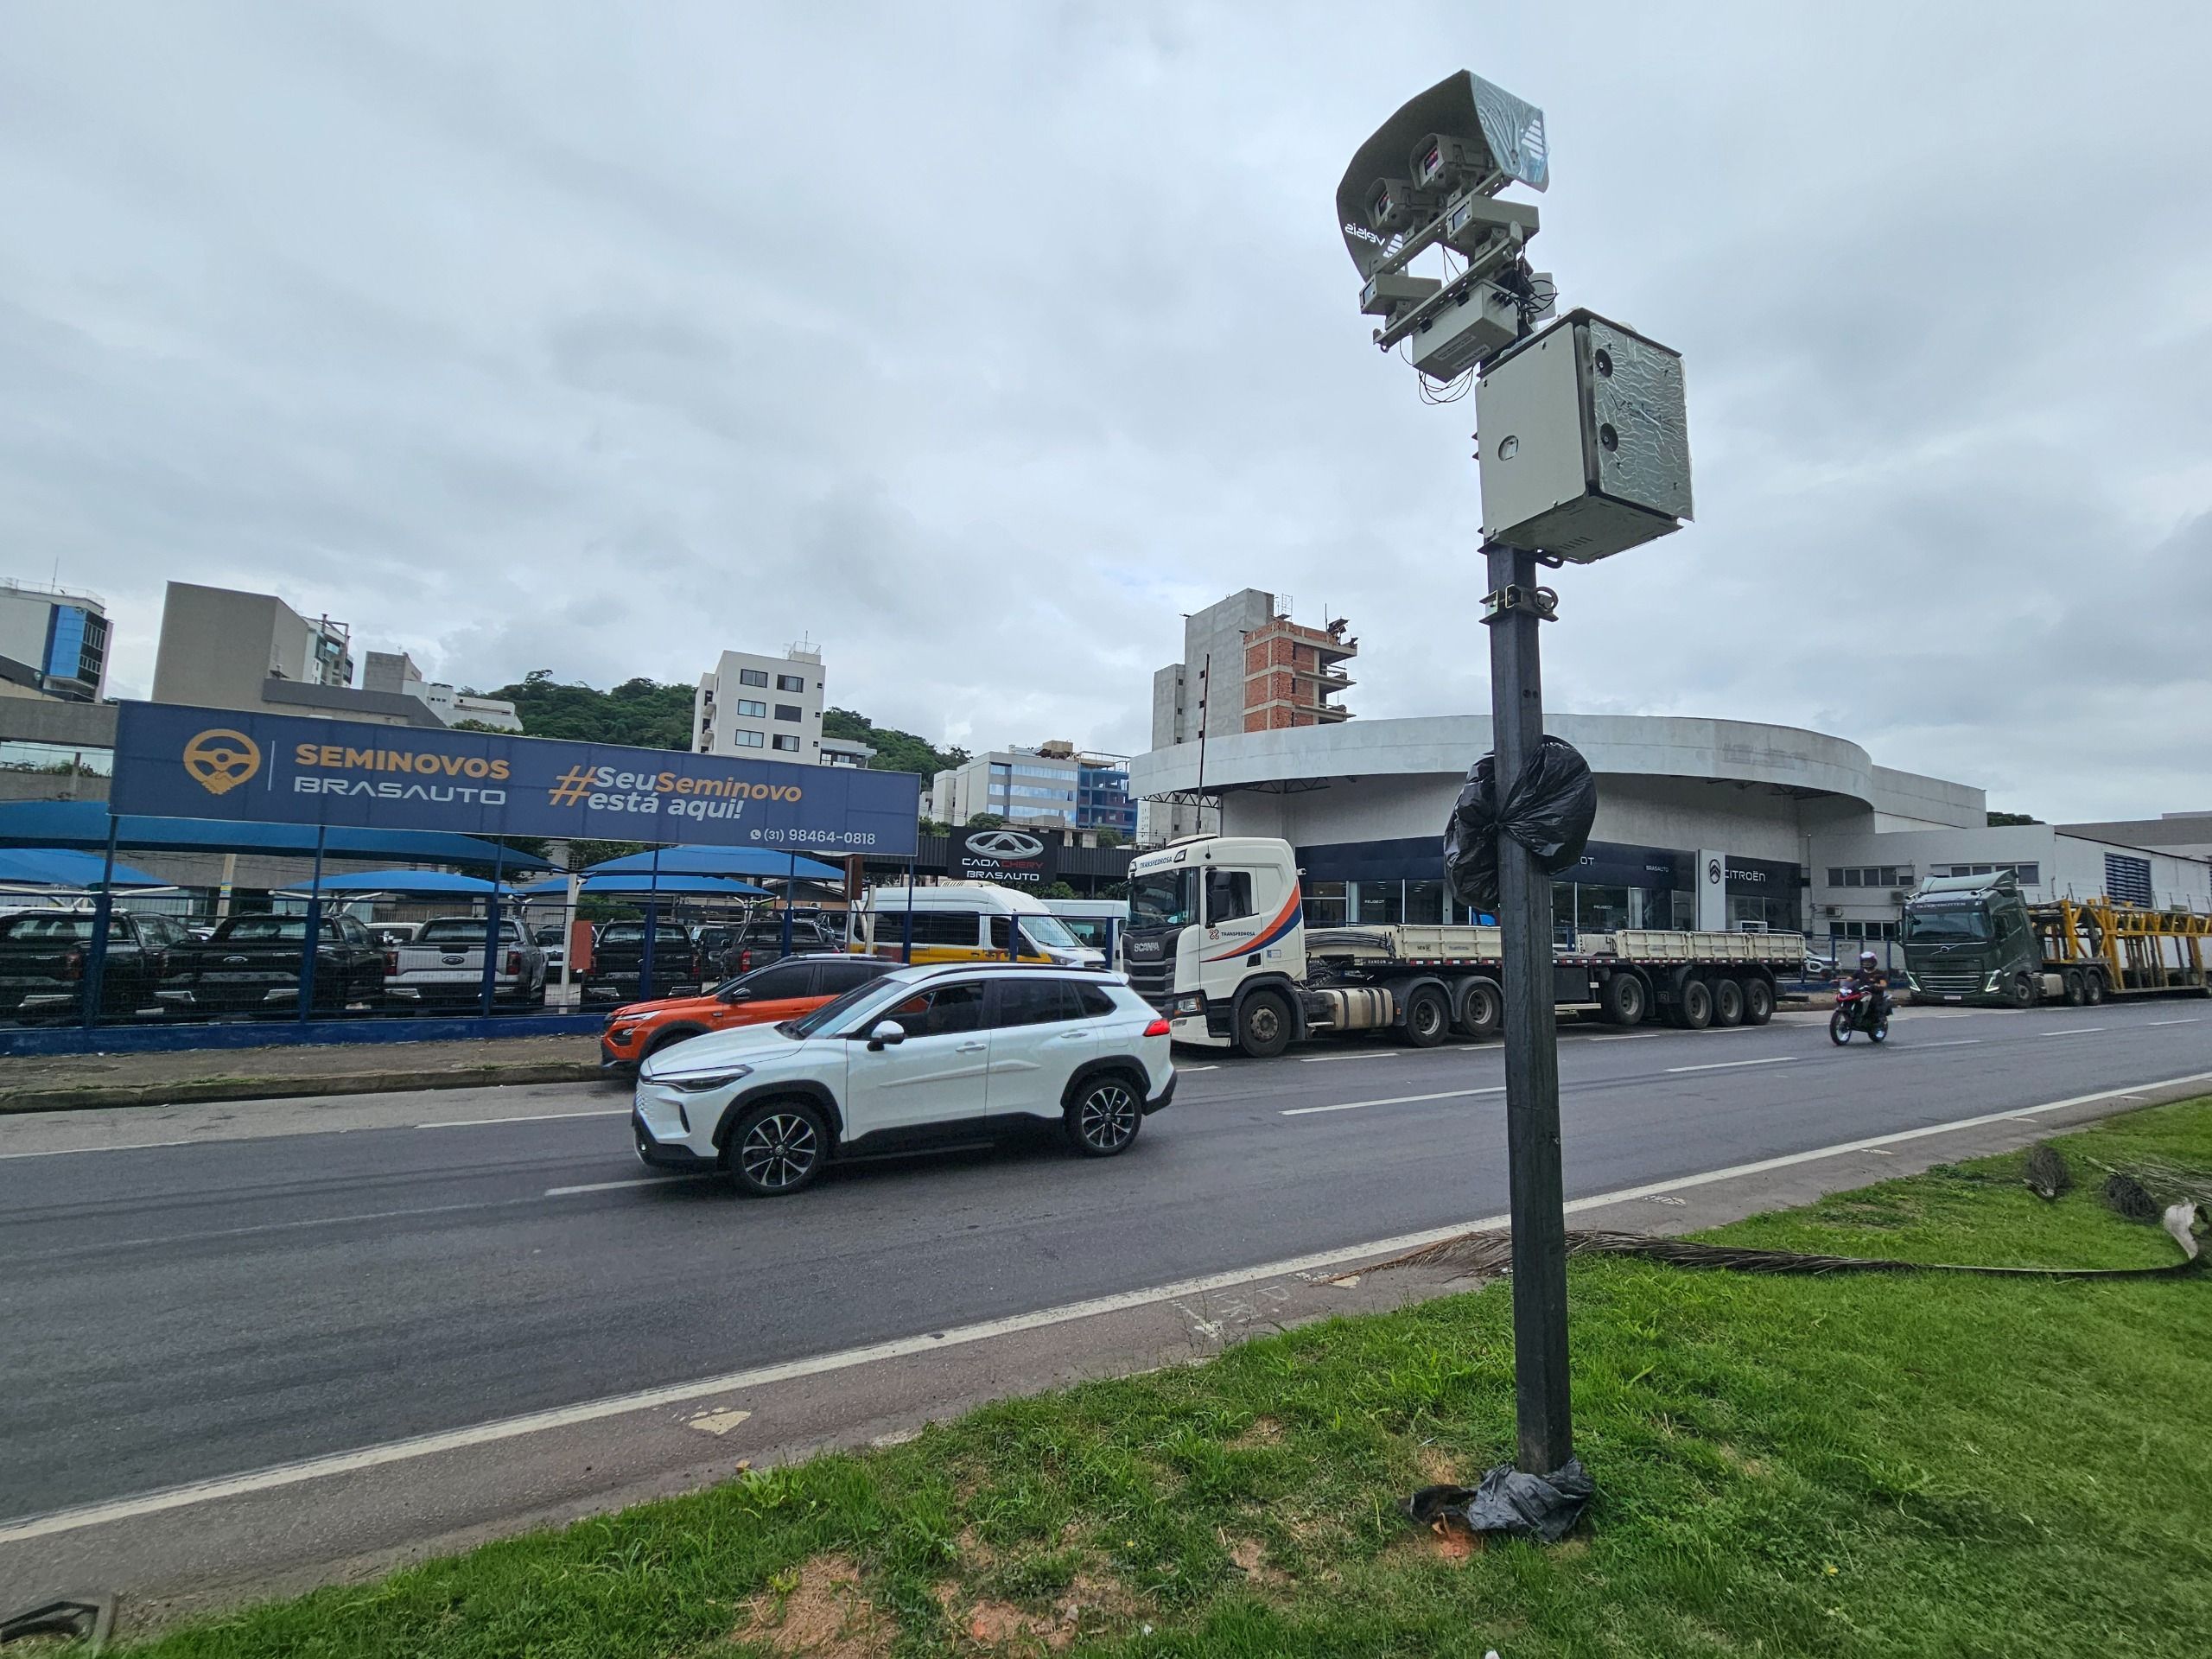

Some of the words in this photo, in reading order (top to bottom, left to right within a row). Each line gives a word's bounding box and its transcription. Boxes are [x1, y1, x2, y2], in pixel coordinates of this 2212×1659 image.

[296, 744, 510, 779] SEMINOVOS
[294, 777, 506, 805] BRASAUTO
[588, 791, 659, 814] está
[667, 798, 745, 821] aqui!
[764, 829, 785, 842] (31)
[789, 829, 875, 845] 98464-0818
[1140, 856, 1173, 868] TRANSPEDROSA
[967, 870, 1039, 881] BRASAUTO
[1134, 942, 1160, 952] SCANIA
